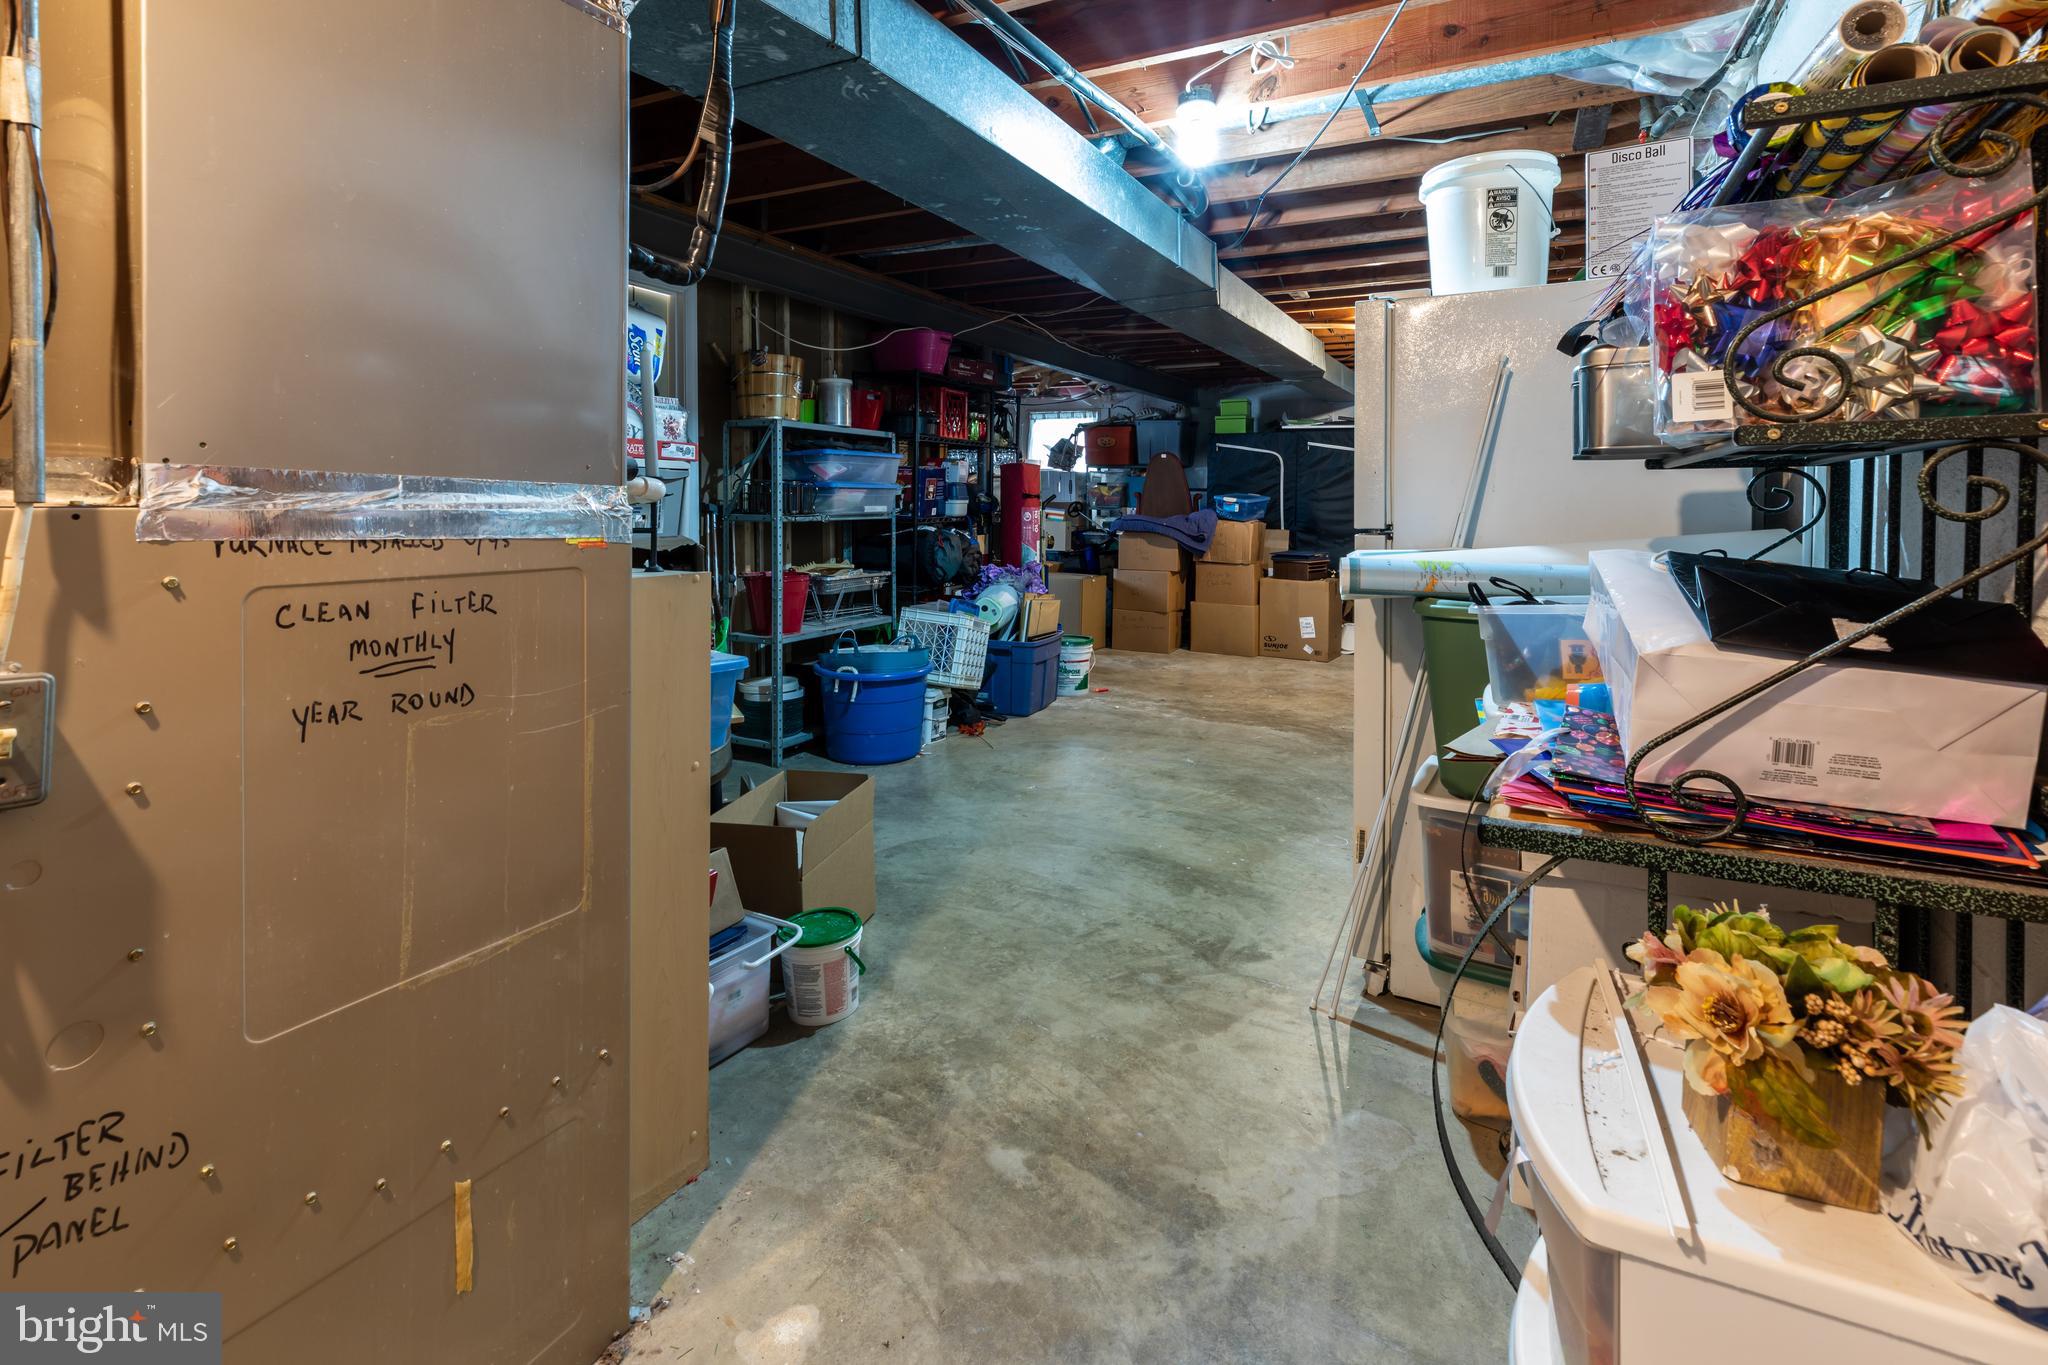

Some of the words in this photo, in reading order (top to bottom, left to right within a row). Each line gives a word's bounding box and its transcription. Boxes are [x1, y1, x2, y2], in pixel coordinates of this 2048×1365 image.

[1612, 150, 1642, 164] Disco
[1645, 144, 1666, 159] Ball
[275, 600, 370, 629] CLEAN
[412, 590, 498, 619] FILTER
[350, 628, 456, 665] MONTHLY
[292, 701, 363, 744] YEAR
[391, 683, 475, 715] ROUND
[0, 1111, 126, 1180] FILTER
[63, 1132, 190, 1202] BEHIND
[12, 1206, 129, 1279] PANEL
